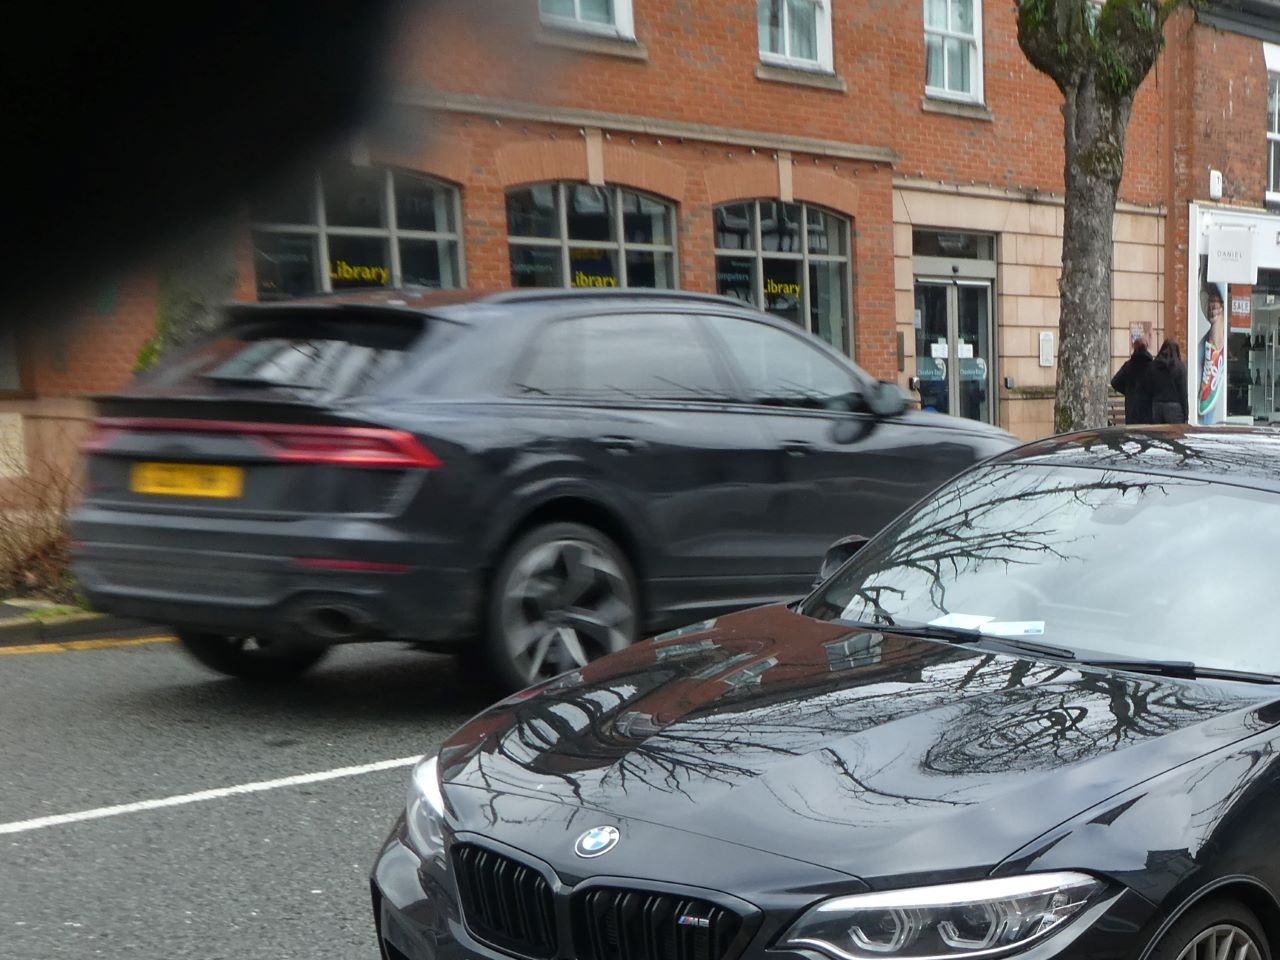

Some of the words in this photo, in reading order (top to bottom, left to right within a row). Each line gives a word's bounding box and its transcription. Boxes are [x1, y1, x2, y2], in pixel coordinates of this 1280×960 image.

[1217, 250, 1243, 258] DANIEL
[328, 259, 390, 285] Library
[1232, 303, 1249, 312] SALE
